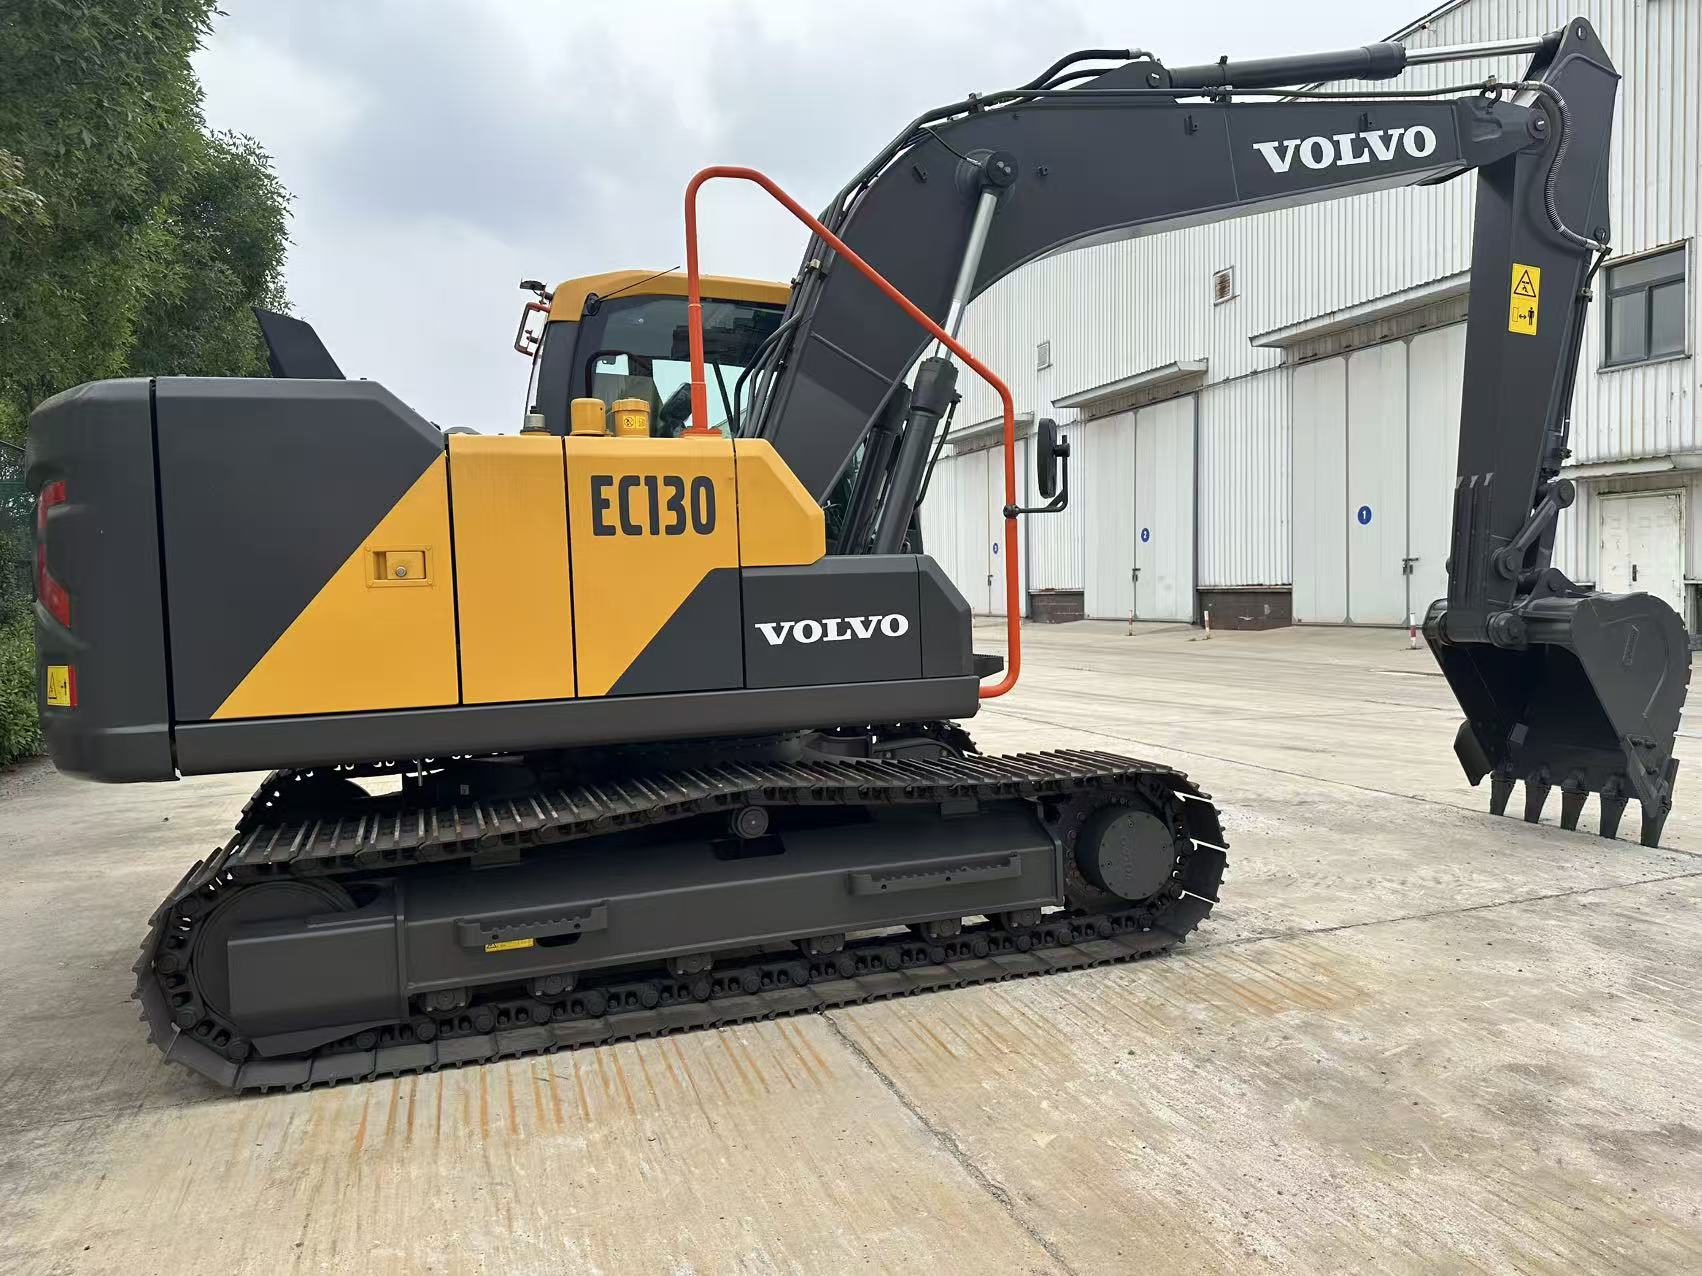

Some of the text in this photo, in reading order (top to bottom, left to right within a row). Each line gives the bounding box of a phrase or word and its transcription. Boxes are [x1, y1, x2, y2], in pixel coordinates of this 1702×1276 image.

[1253, 126, 1437, 173] VOLVO
[591, 475, 716, 536] EC130
[755, 614, 909, 645] VOLVO
